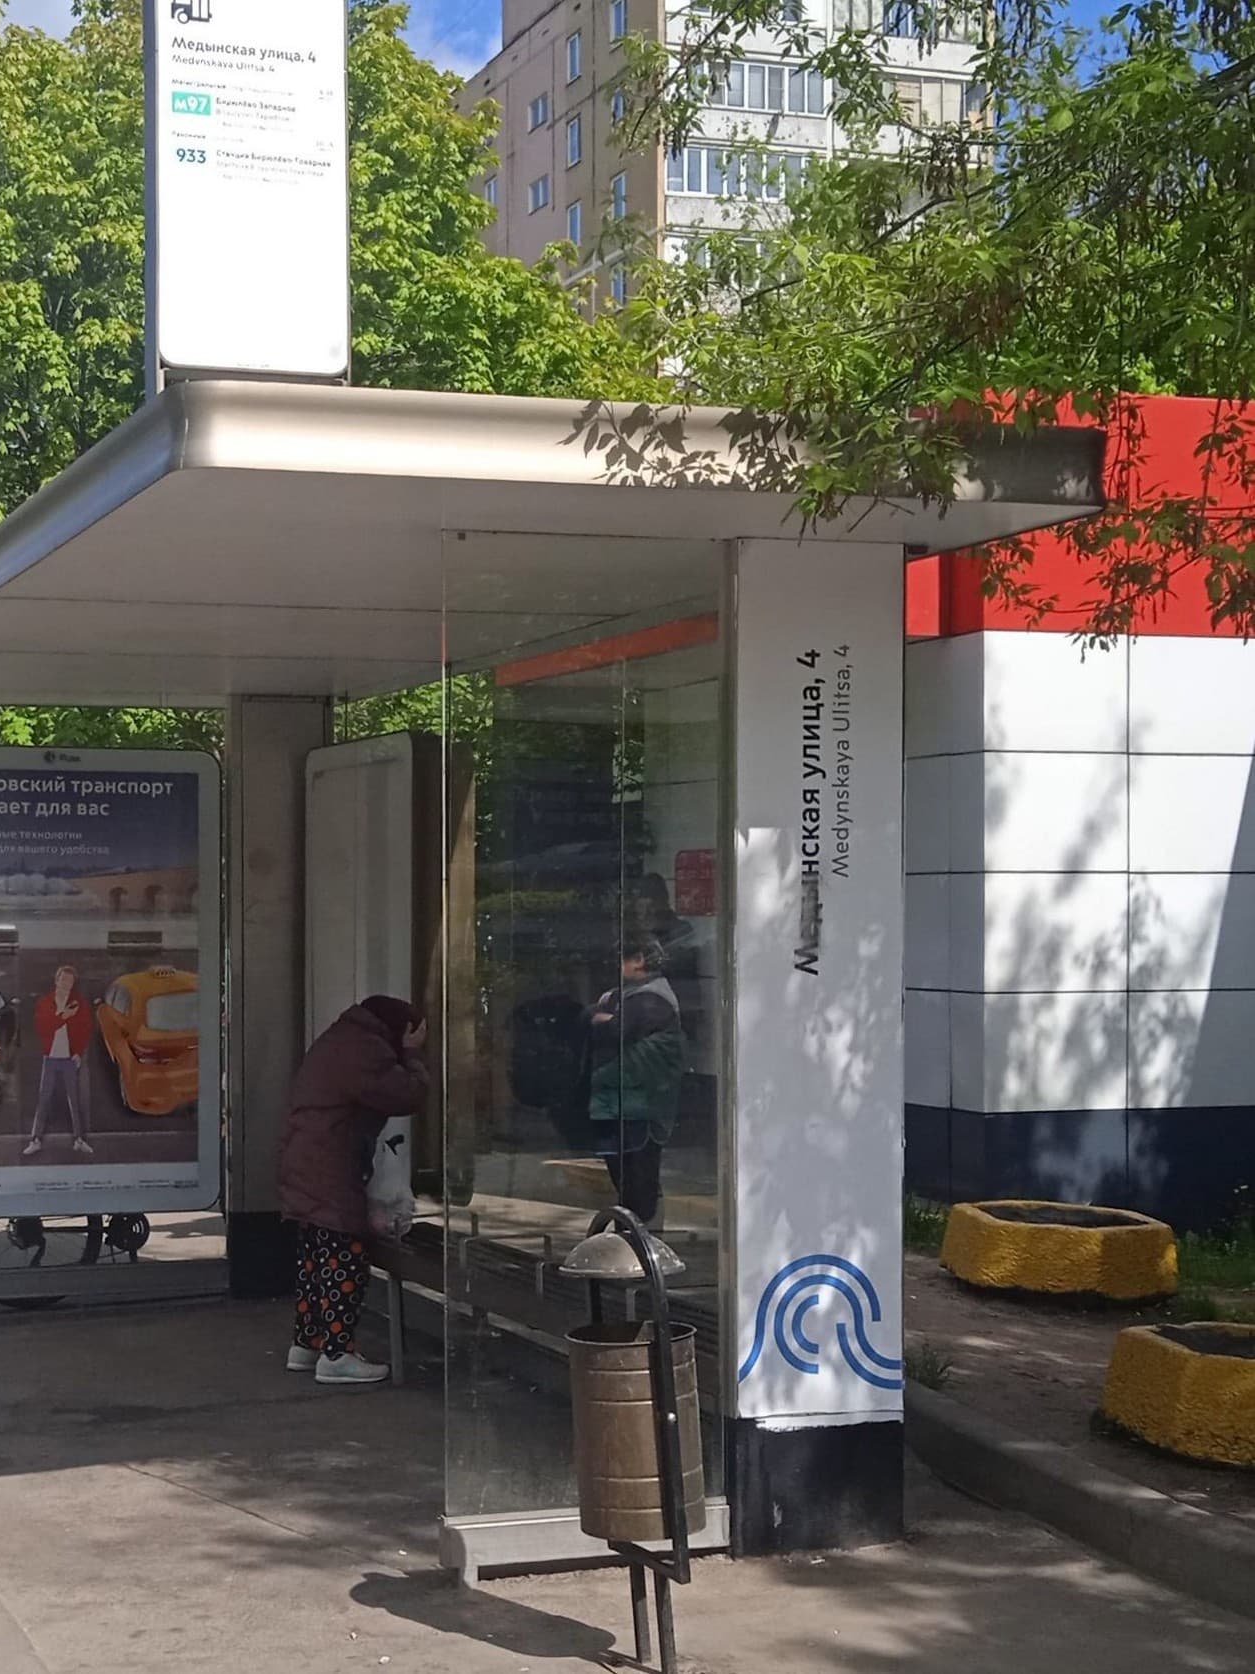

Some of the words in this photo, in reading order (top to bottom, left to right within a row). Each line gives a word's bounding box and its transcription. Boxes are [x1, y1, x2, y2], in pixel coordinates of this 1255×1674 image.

[171, 36, 256, 57] Медынская
[307, 50, 317, 64] 4
[176, 147, 207, 164] 933
[796, 648, 820, 668] 4
[833, 644, 850, 658] 4
[832, 663, 852, 732] Ulitsa,
[801, 677, 826, 780] улица,
[70, 779, 173, 797] транспорт
[35, 802, 71, 817] для
[77, 802, 110, 816] вас
[831, 739, 854, 878] Medynskaya
[20, 831, 82, 840] технологии
[794, 788, 822, 976] Мнская
